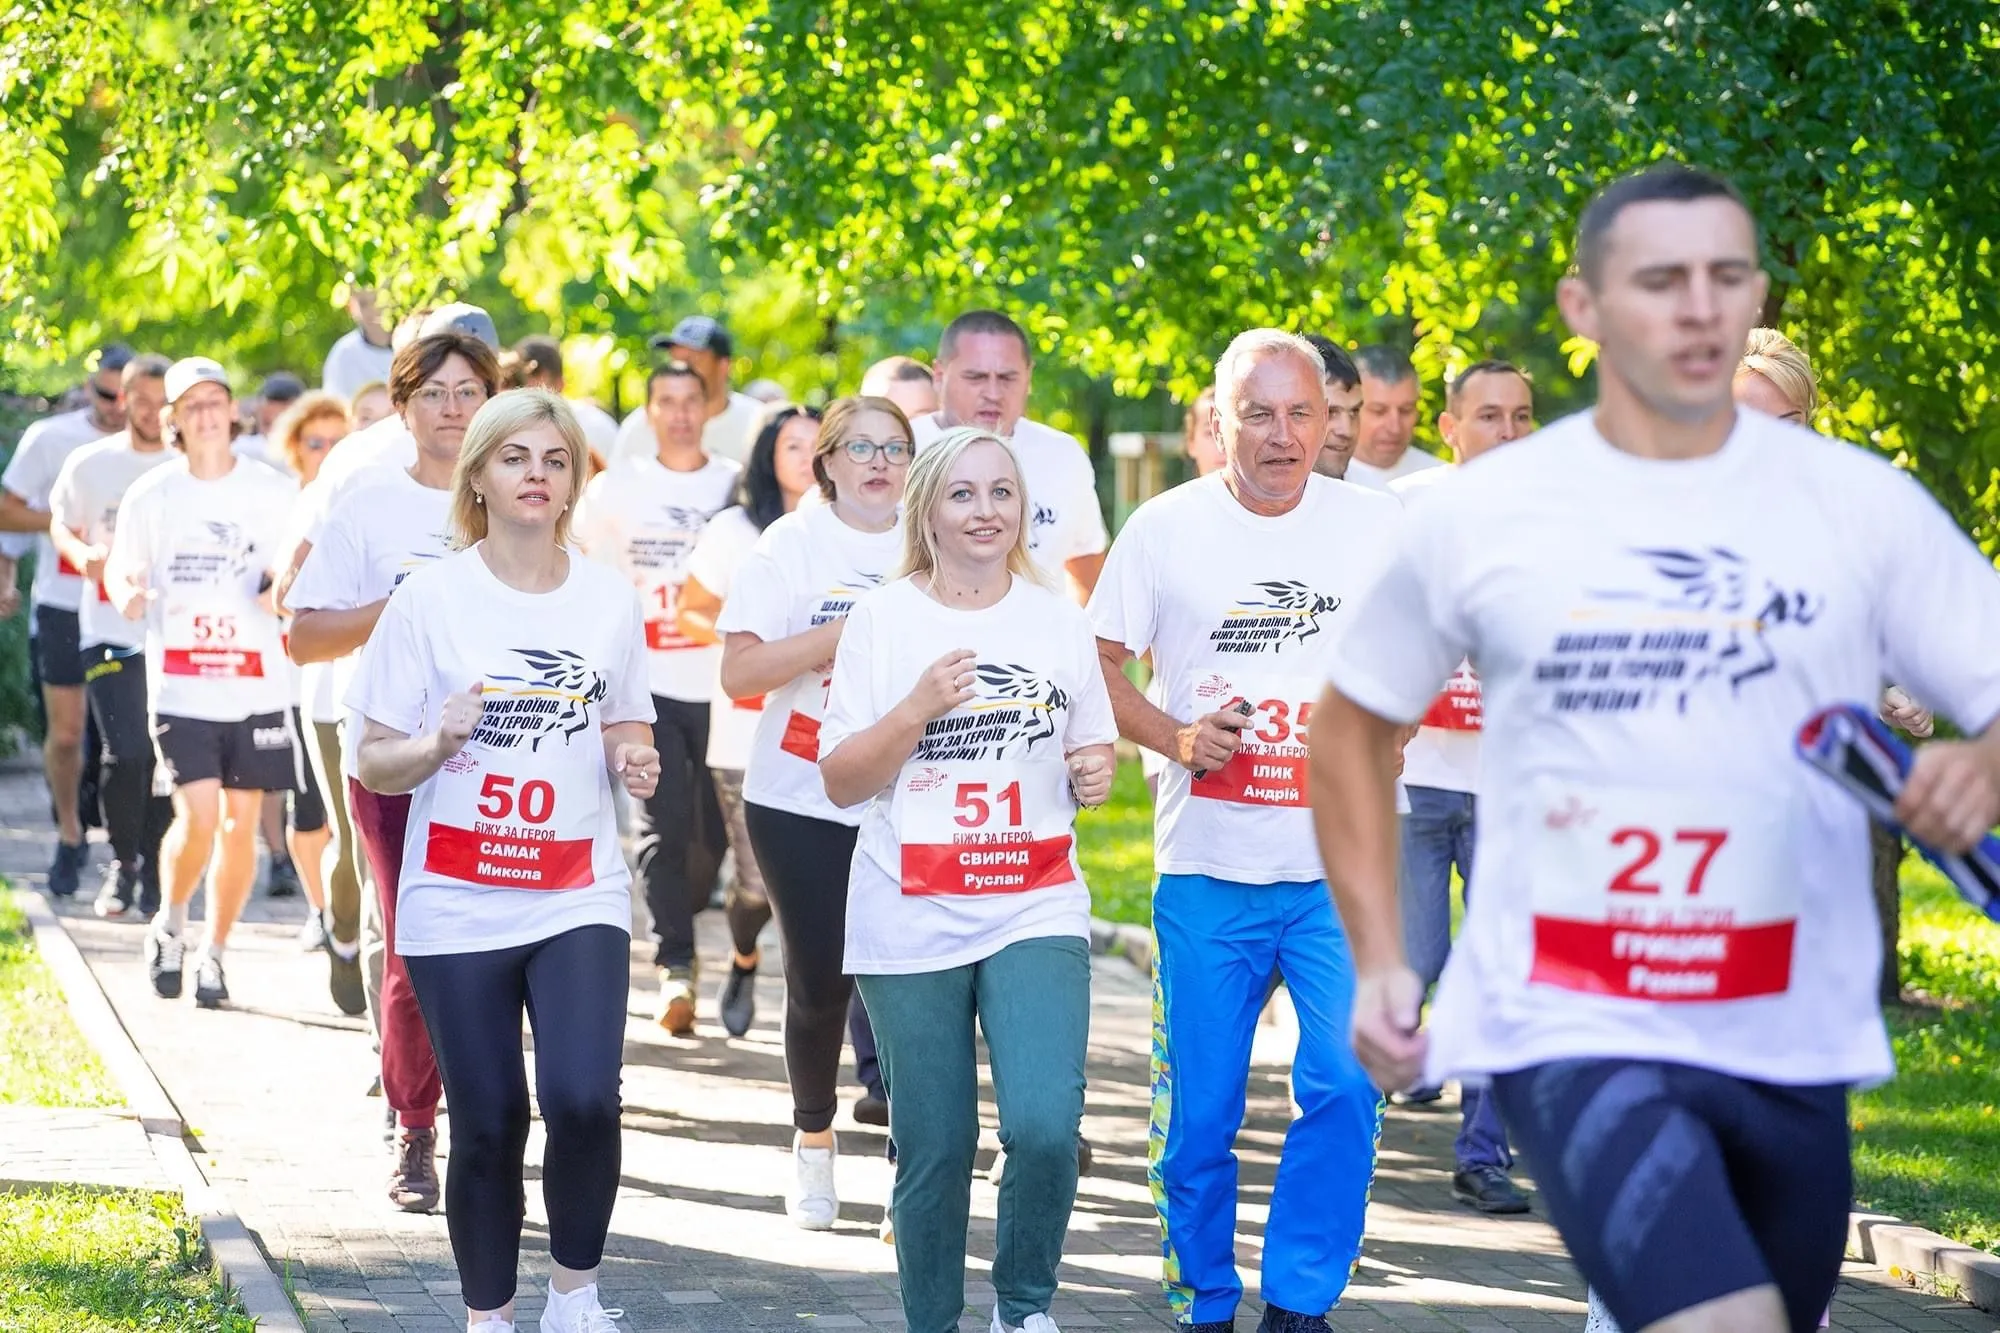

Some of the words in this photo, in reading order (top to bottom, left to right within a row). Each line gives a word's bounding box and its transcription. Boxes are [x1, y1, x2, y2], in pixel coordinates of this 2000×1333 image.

[820, 600, 856, 612] ШАНУ
[193, 614, 236, 641] 55
[1222, 618, 1258, 629] ШАНУЮ
[1259, 616, 1292, 628] ВОЇНІВ,
[1210, 630, 1235, 640] БІЖУ
[1235, 631, 1248, 640] ЗА
[1248, 628, 1280, 640] ГЕРОЇВ
[1216, 641, 1260, 653] УКРАЇНИ
[483, 700, 514, 713] НУЮ
[514, 697, 559, 715] ВОЇНІВ,
[483, 715, 500, 728] ЗА
[500, 714, 543, 729] ГЕРОЇВ
[925, 715, 975, 736] ШАНУЮ
[976, 709, 1021, 727] ВОЇНІВ,
[470, 728, 516, 748] РАЇНИ
[943, 735, 962, 748] ЗА
[962, 726, 1006, 745] ГЕРОЇВ
[1241, 743, 1260, 754] ІЖУ
[1264, 745, 1276, 756] ЗА
[1253, 764, 1294, 779] ІЛИК
[477, 773, 556, 824] 50
[1243, 784, 1300, 801] Андрій
[953, 780, 1022, 827] 51
[474, 821, 502, 836] БІЖУ
[504, 826, 517, 838] ЗА
[521, 828, 556, 841] ГЕРОЯ
[953, 833, 980, 844] БІЖУ
[984, 833, 997, 844] ЗА
[1001, 831, 1034, 844] ГЕРОЯ
[480, 841, 541, 860] САМАК
[959, 850, 1029, 866] СВИРИД
[1606, 827, 1730, 896] 27
[477, 861, 542, 880] Микола
[964, 873, 1024, 889] Руслан
